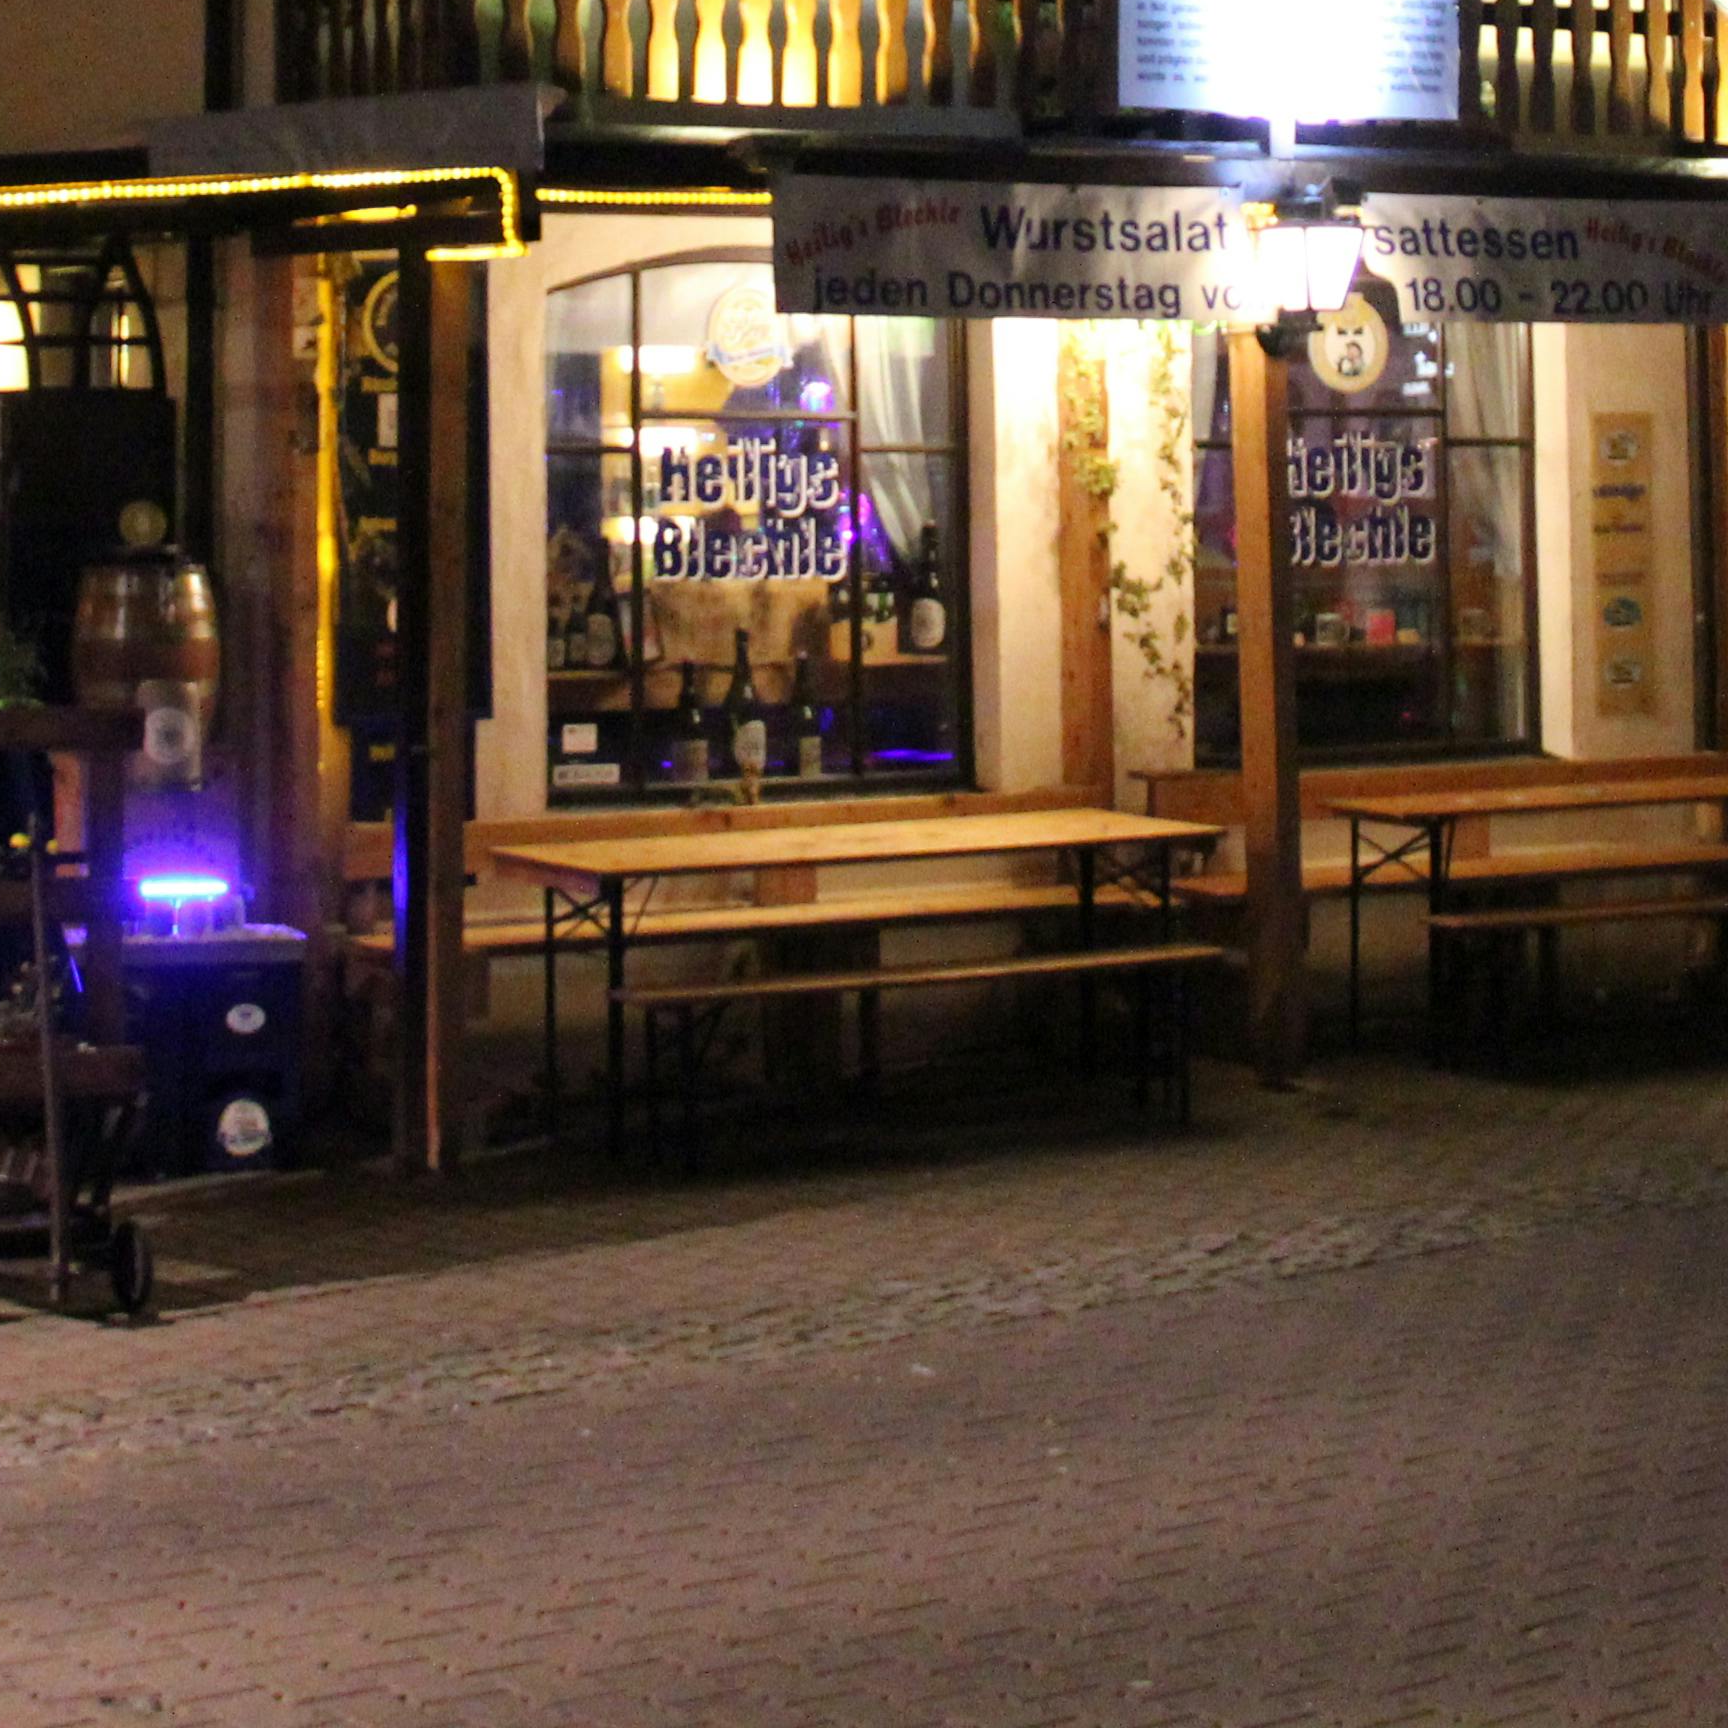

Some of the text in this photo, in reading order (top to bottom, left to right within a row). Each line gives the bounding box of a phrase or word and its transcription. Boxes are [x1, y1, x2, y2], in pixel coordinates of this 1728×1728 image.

[979, 202, 1229, 253] Wurstsalat
[813, 267, 929, 313] jeden
[949, 271, 1182, 318] Donnerstag
[1405, 278, 1501, 315] 18.00
[1550, 278, 1649, 315] 22.00
[1664, 280, 1713, 315] Uhr
